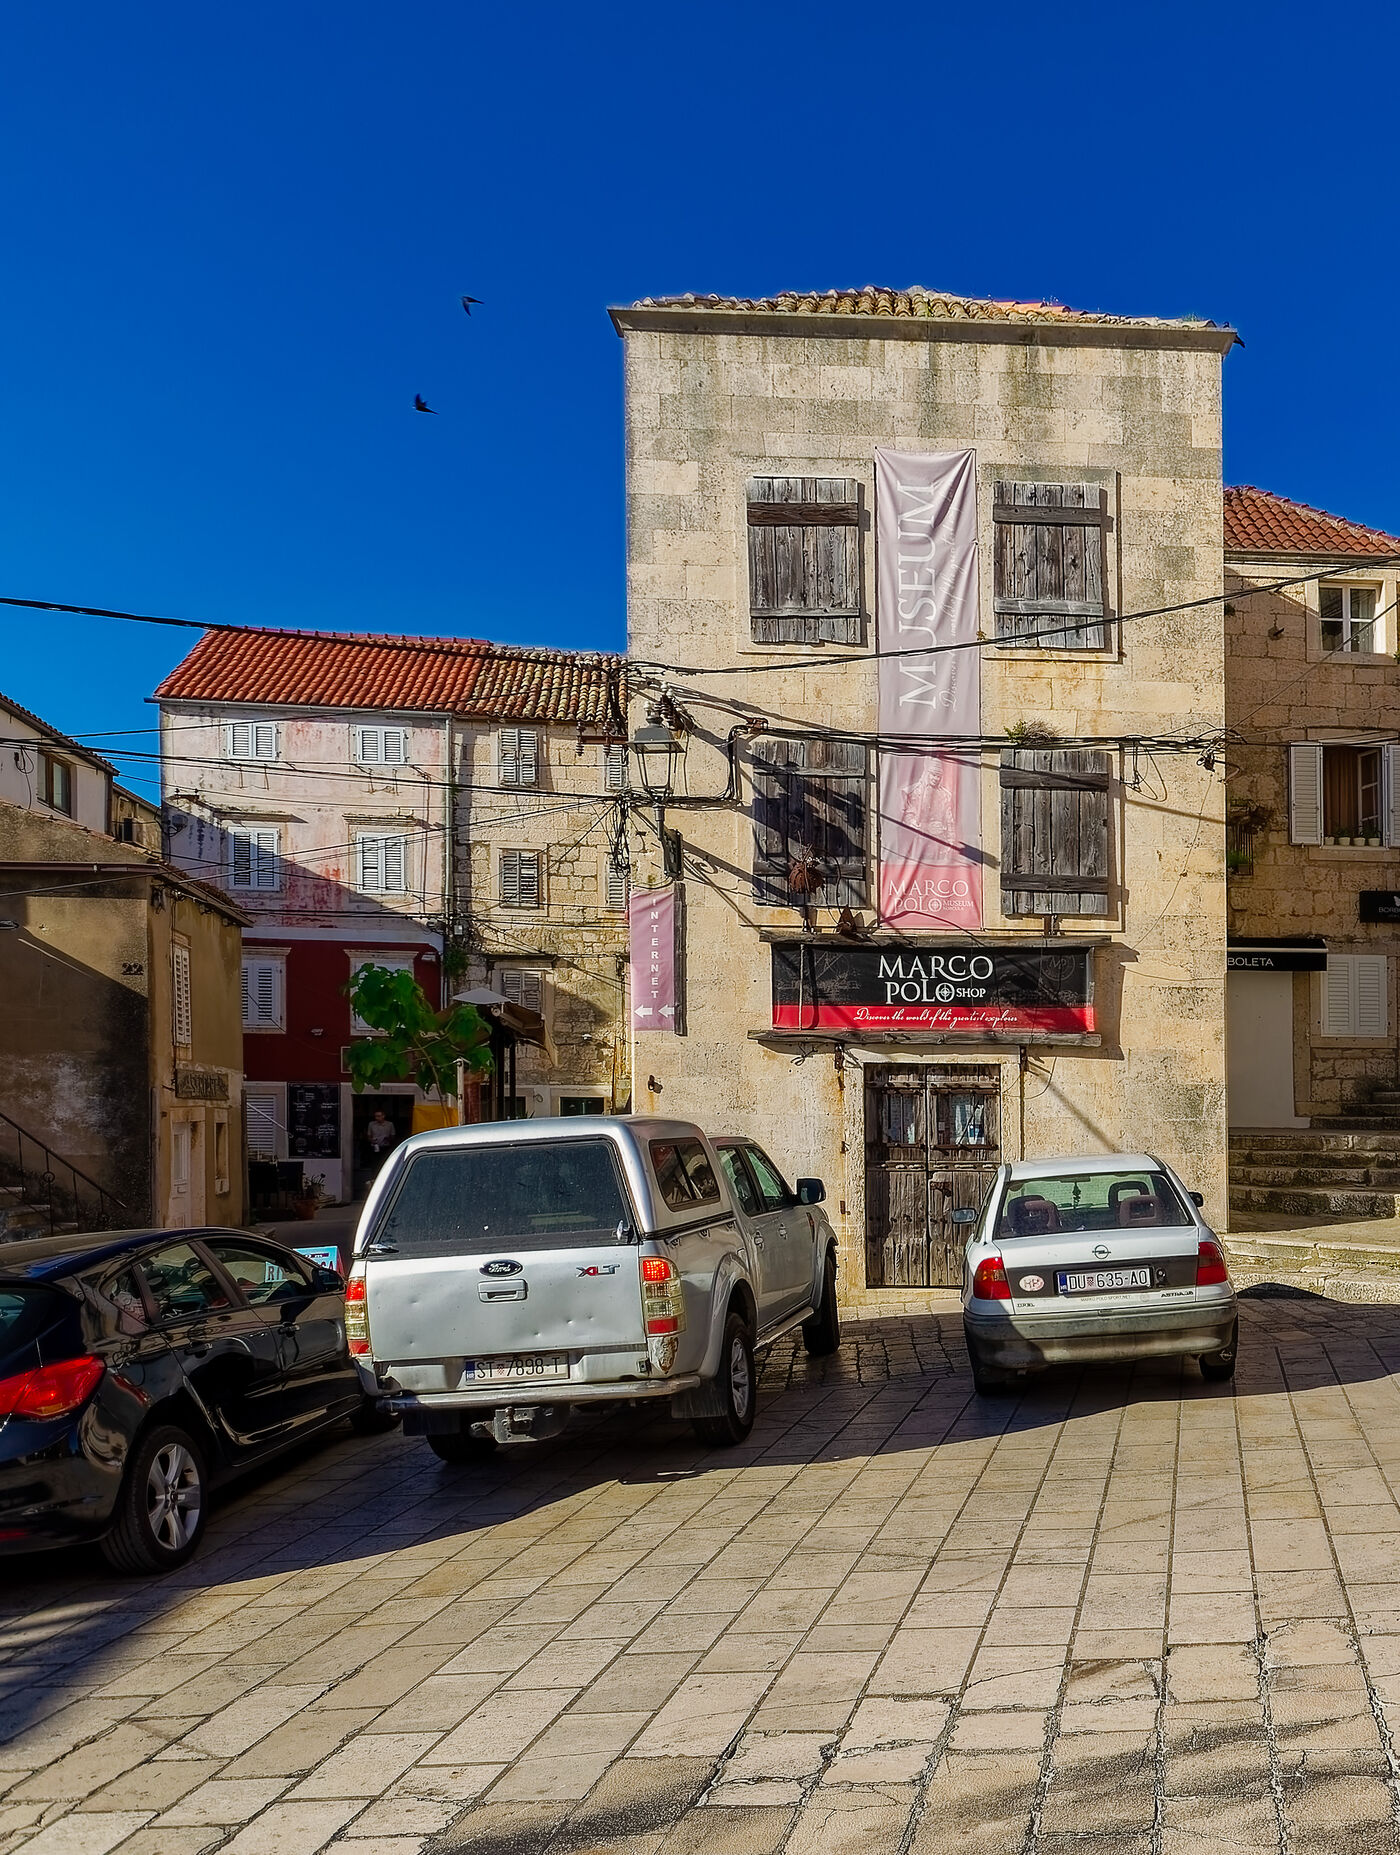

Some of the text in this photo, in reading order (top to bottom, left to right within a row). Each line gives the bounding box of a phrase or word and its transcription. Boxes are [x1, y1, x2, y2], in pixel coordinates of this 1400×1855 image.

[897, 479, 937, 709] MUSEUM
[888, 879, 969, 898] MARCO
[893, 896, 943, 914] POLO
[650, 898, 659, 999] INTERNET
[877, 955, 993, 982] MARCO
[1227, 957, 1274, 967] BOLETA
[885, 979, 986, 1005] POLO SHOP
[853, 1007, 1018, 1029] Discover the world of the greatest explorer
[488, 1263, 511, 1273] Ford
[575, 1263, 621, 1278] XLT
[1069, 1270, 1148, 1290] DU 635-AO
[477, 1361, 494, 1379] ST
